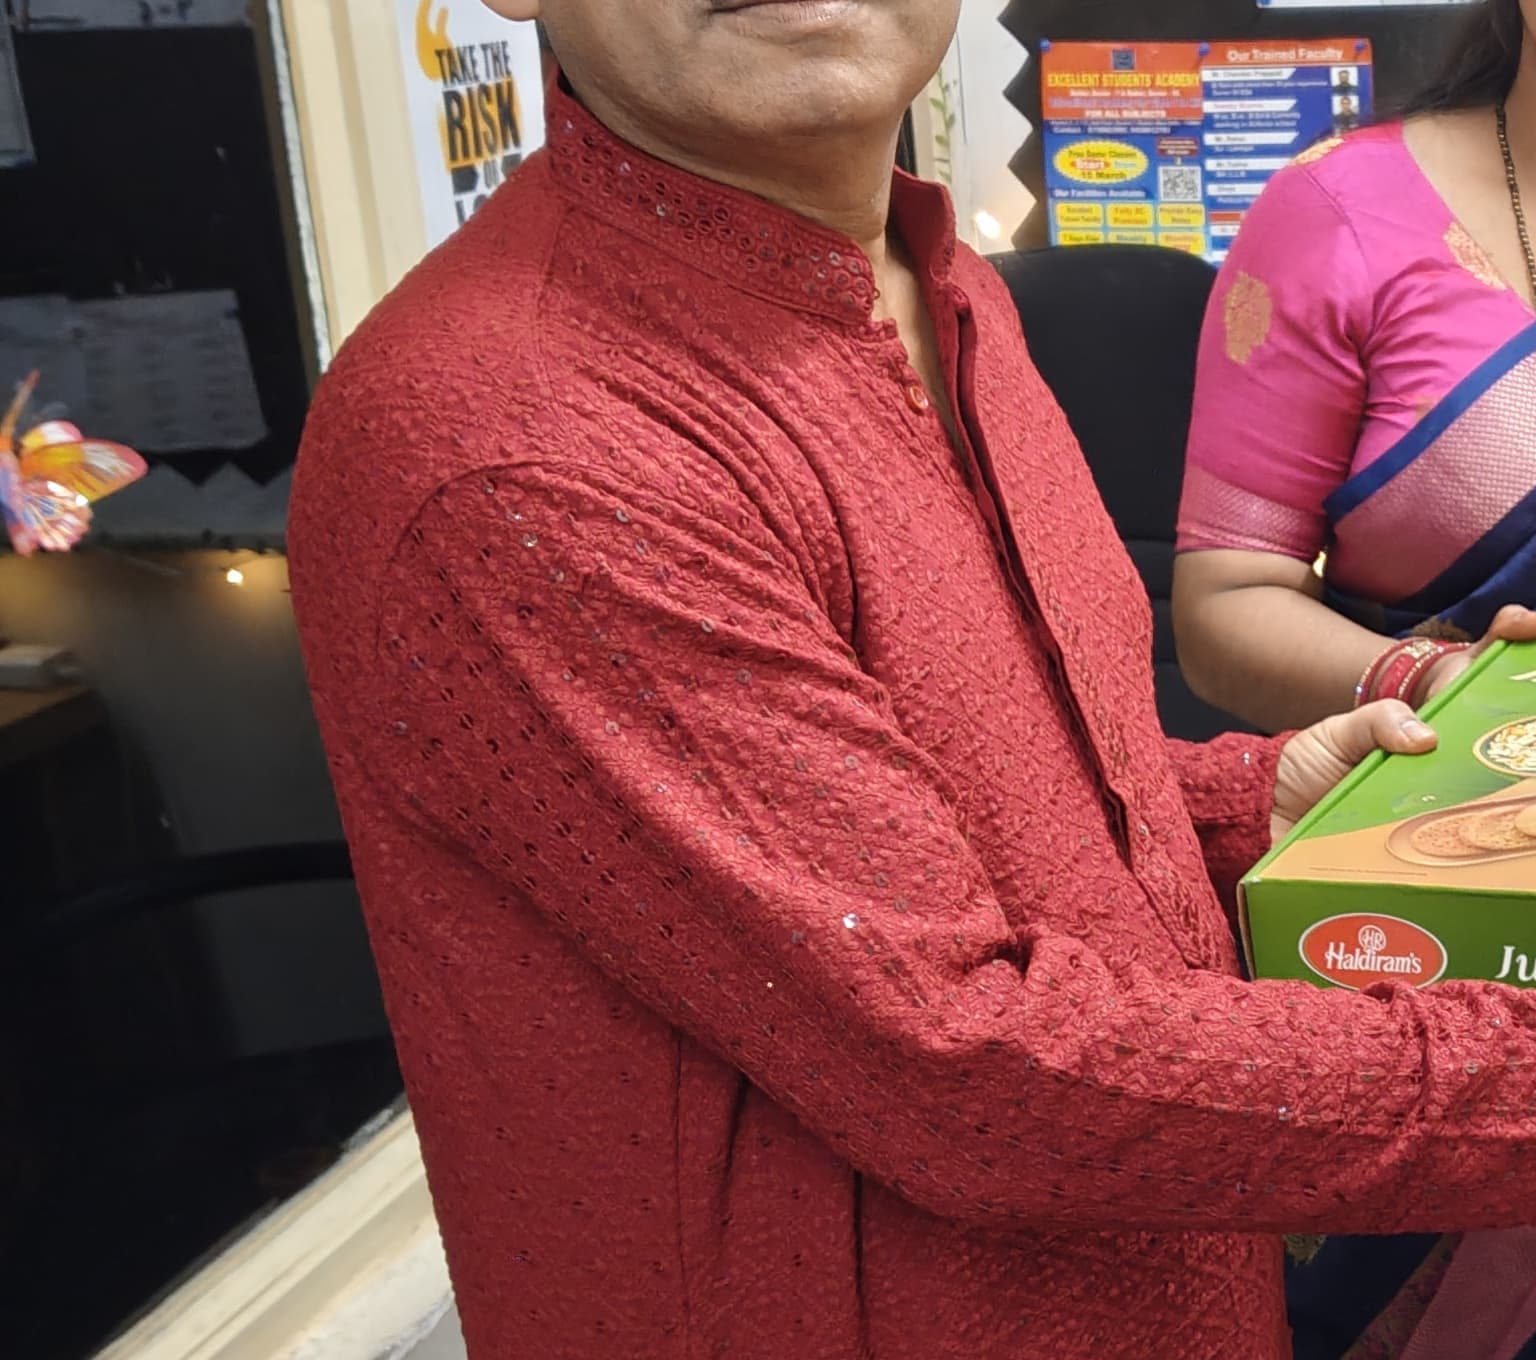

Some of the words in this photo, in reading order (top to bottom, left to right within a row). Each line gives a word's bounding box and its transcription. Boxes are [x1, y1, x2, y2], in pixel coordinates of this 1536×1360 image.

[435, 43, 479, 89] TAKE
[480, 40, 512, 81] THE
[1226, 49, 1250, 62] Our
[1251, 48, 1296, 61] Trained
[1298, 46, 1344, 61] Faculty
[441, 78, 522, 163] RISK
[1325, 940, 1422, 975] Haldiram's
